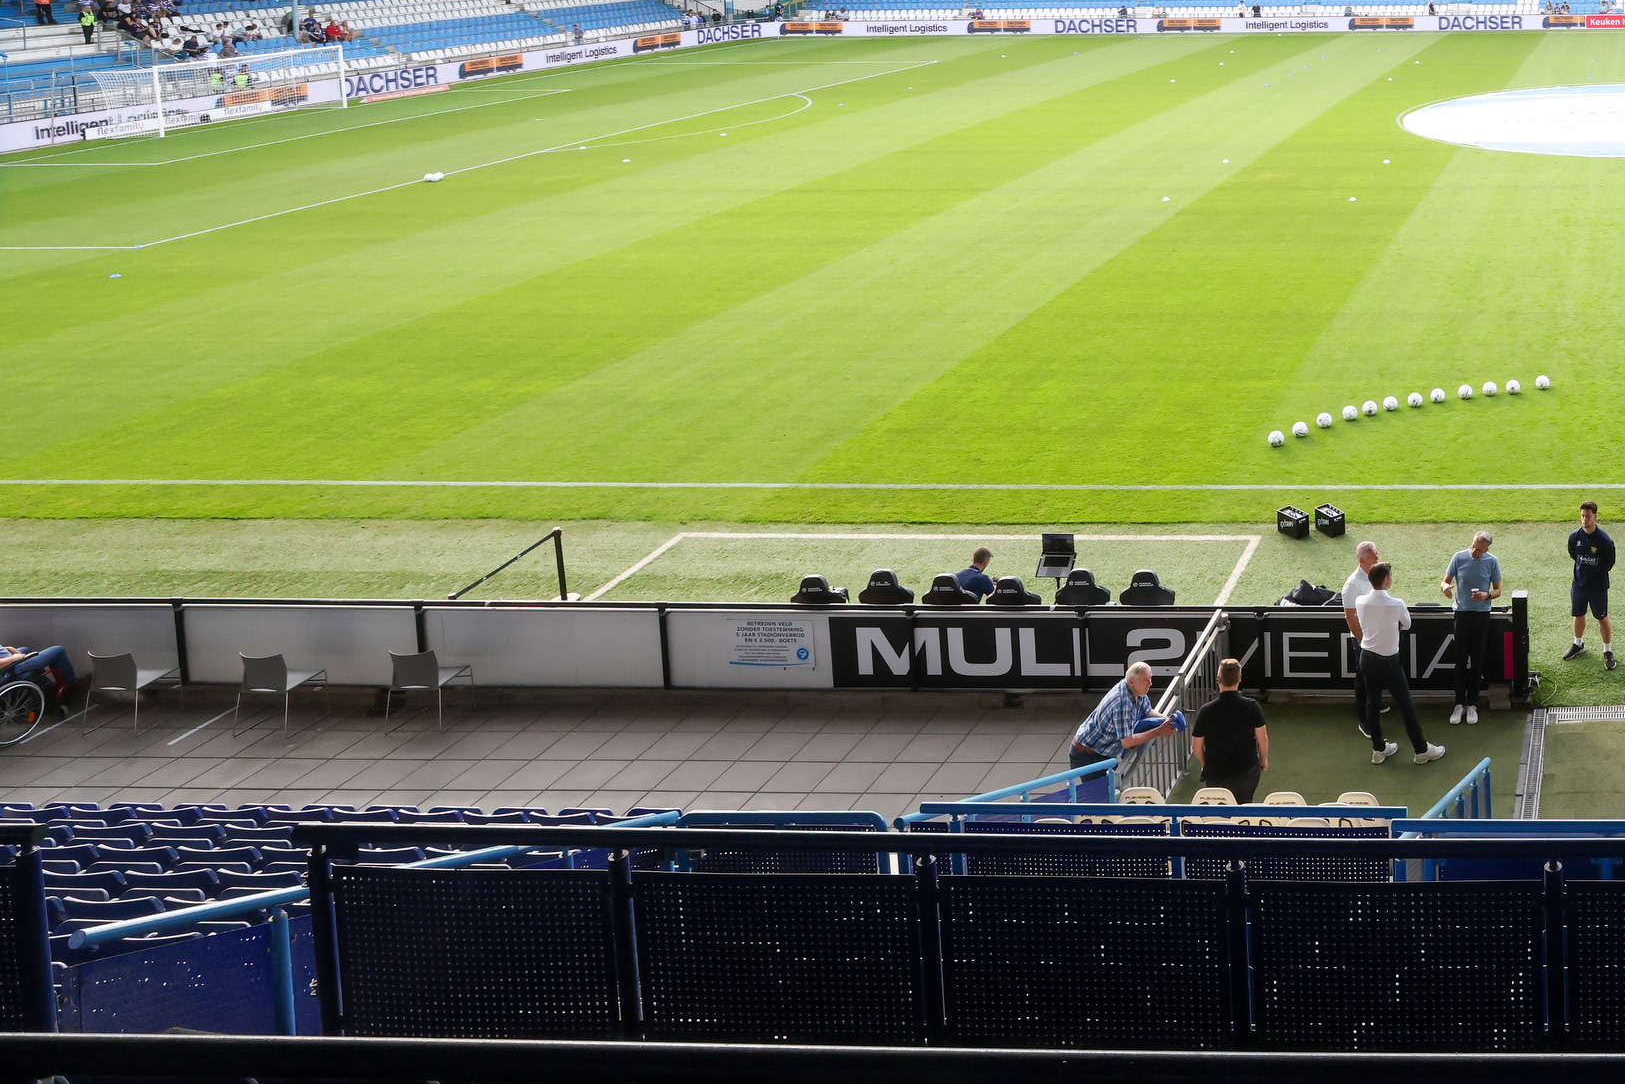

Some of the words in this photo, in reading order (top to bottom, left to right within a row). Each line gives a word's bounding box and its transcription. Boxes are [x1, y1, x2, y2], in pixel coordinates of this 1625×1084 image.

[866, 24, 907, 33] Intelligent
[910, 23, 948, 33] Logistics
[1054, 19, 1138, 33] DACHSER
[1245, 21, 1288, 30] Intelligent
[1290, 21, 1329, 30] Logistics
[1438, 15, 1523, 30] DACHSER
[1590, 18, 1620, 26] Keuken
[697, 23, 762, 44] DACHSER
[546, 49, 583, 64] Intelligent
[585, 46, 618, 60] Logistics
[340, 66, 439, 97] DACHSER
[224, 103, 263, 115] flexfamily
[97, 121, 144, 135] flexfamily
